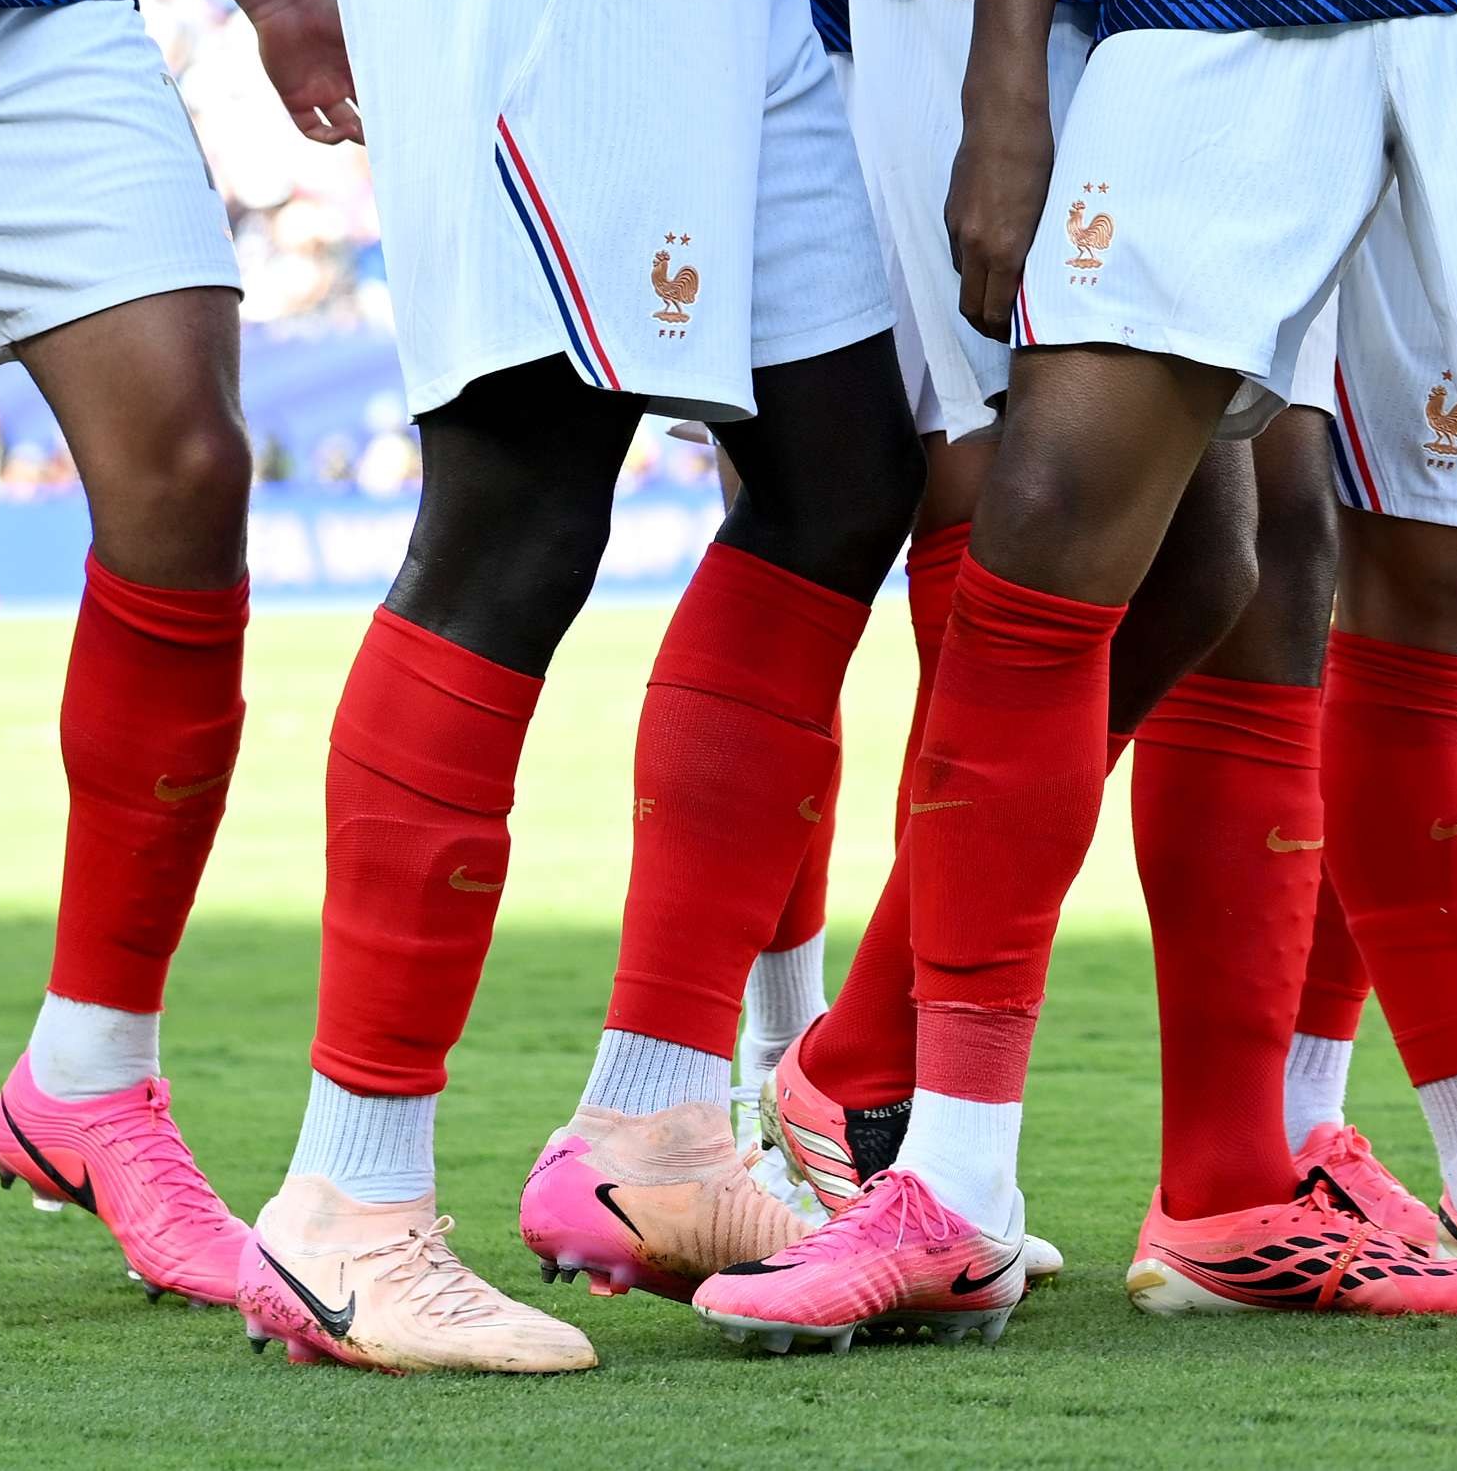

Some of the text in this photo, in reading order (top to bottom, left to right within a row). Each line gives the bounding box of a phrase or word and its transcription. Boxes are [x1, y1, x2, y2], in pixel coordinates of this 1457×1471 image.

[1070, 276, 1097, 286] FFF
[659, 330, 686, 340] FFF
[864, 1107, 892, 1120] 1994
